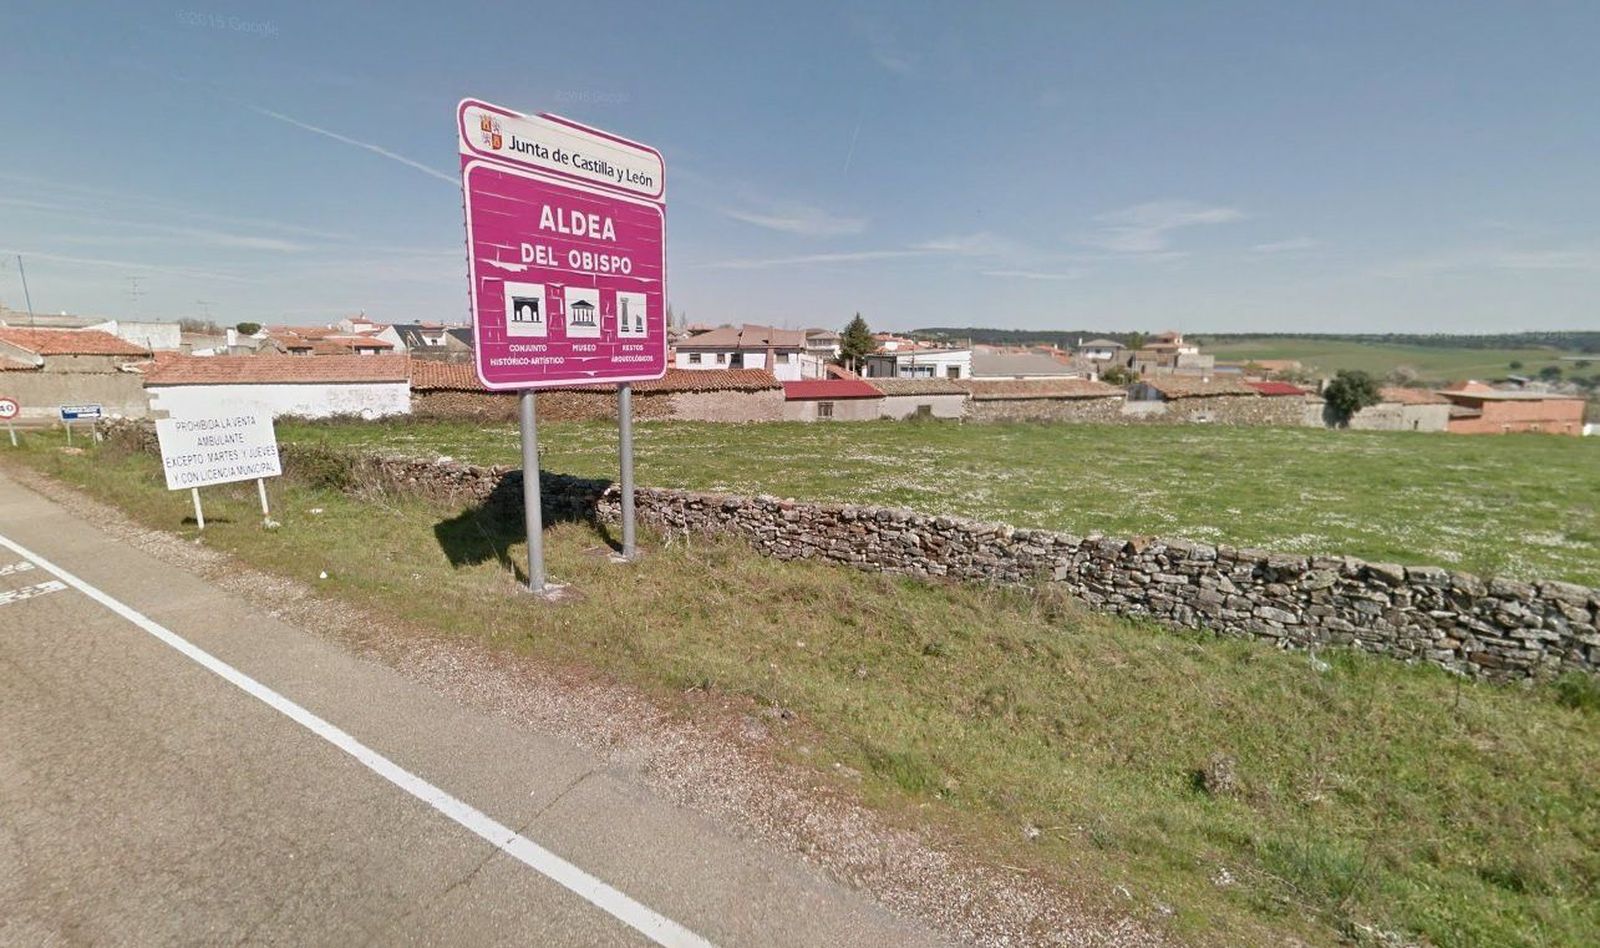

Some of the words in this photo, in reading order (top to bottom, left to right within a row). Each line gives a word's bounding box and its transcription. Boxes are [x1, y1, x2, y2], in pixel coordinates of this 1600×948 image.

[509, 135, 549, 160] Junta
[552, 148, 569, 165] de
[572, 154, 615, 177] Castilla
[616, 169, 624, 182] y
[626, 169, 653, 188] León
[539, 204, 616, 241] ALDEA
[521, 243, 558, 266] DEL
[568, 249, 632, 274] OBISPO
[509, 344, 548, 352] CONJUNTO
[572, 343, 597, 351] MUSEO
[490, 356, 565, 366] HISTÓRICO-ARTÍSTICO
[176, 418, 220, 431] PROHIBIDA
[222, 418, 232, 429] LA
[233, 416, 256, 427] VENTA
[198, 433, 244, 446] AMBULANTE
[166, 454, 204, 468] EXCEPTO
[207, 449, 238, 462] MARTES
[249, 445, 276, 458] JUEVES
[181, 471, 199, 484] CON
[201, 466, 236, 481] LICENCIA
[236, 462, 275, 476] MUNICIPAL
